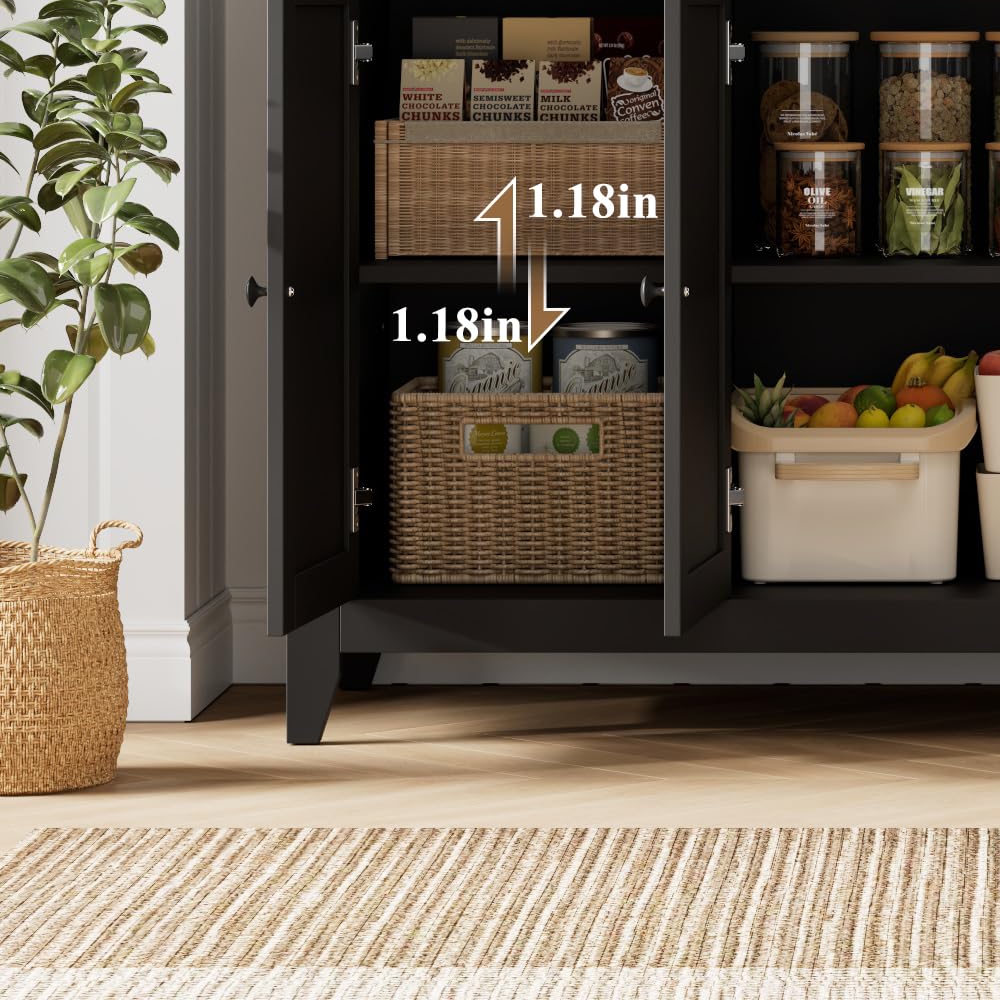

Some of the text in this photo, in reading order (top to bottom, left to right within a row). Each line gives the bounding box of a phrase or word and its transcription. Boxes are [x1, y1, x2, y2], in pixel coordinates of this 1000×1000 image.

[402, 93, 443, 101] WHITE
[540, 95, 571, 103] MILK
[629, 89, 657, 104] original
[617, 99, 660, 117] Conven
[401, 112, 460, 121] CHUNKS
[472, 112, 532, 121] CHUNKS
[540, 113, 598, 121] CHUNKS
[803, 187, 832, 196] OLIVE
[905, 187, 944, 196] VINEGAR
[807, 196, 827, 204] OIL
